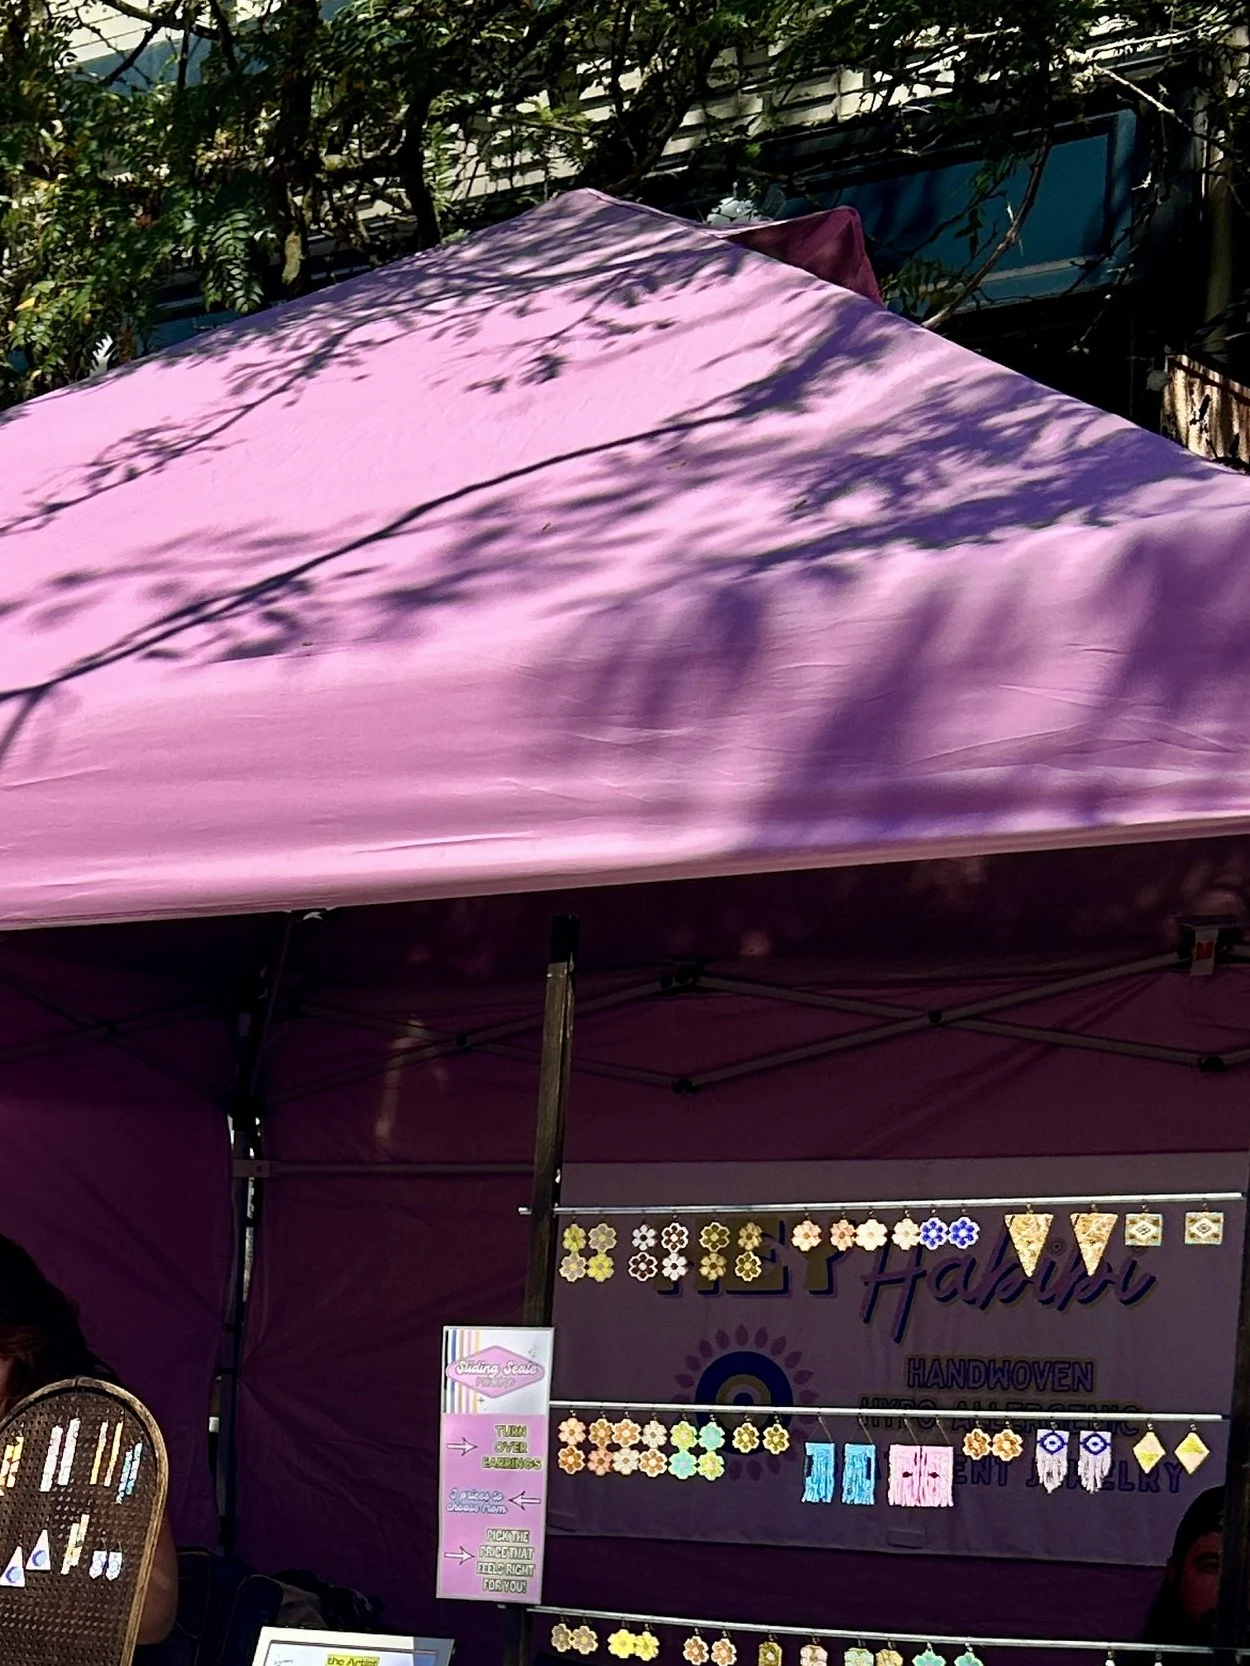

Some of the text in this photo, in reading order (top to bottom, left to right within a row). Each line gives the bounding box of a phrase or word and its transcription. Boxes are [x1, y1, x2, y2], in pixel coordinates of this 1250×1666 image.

[456, 1360, 539, 1377] Sliding Scale
[907, 1358, 1094, 1392] HANDWOVEN
[494, 1424, 527, 1438] TURN
[494, 1441, 527, 1454] OVER
[482, 1456, 543, 1470] EARRINGS
[486, 1529, 529, 1543] PICK THE
[509, 1547, 534, 1560] THAT
[505, 1563, 535, 1577] RIGHT
